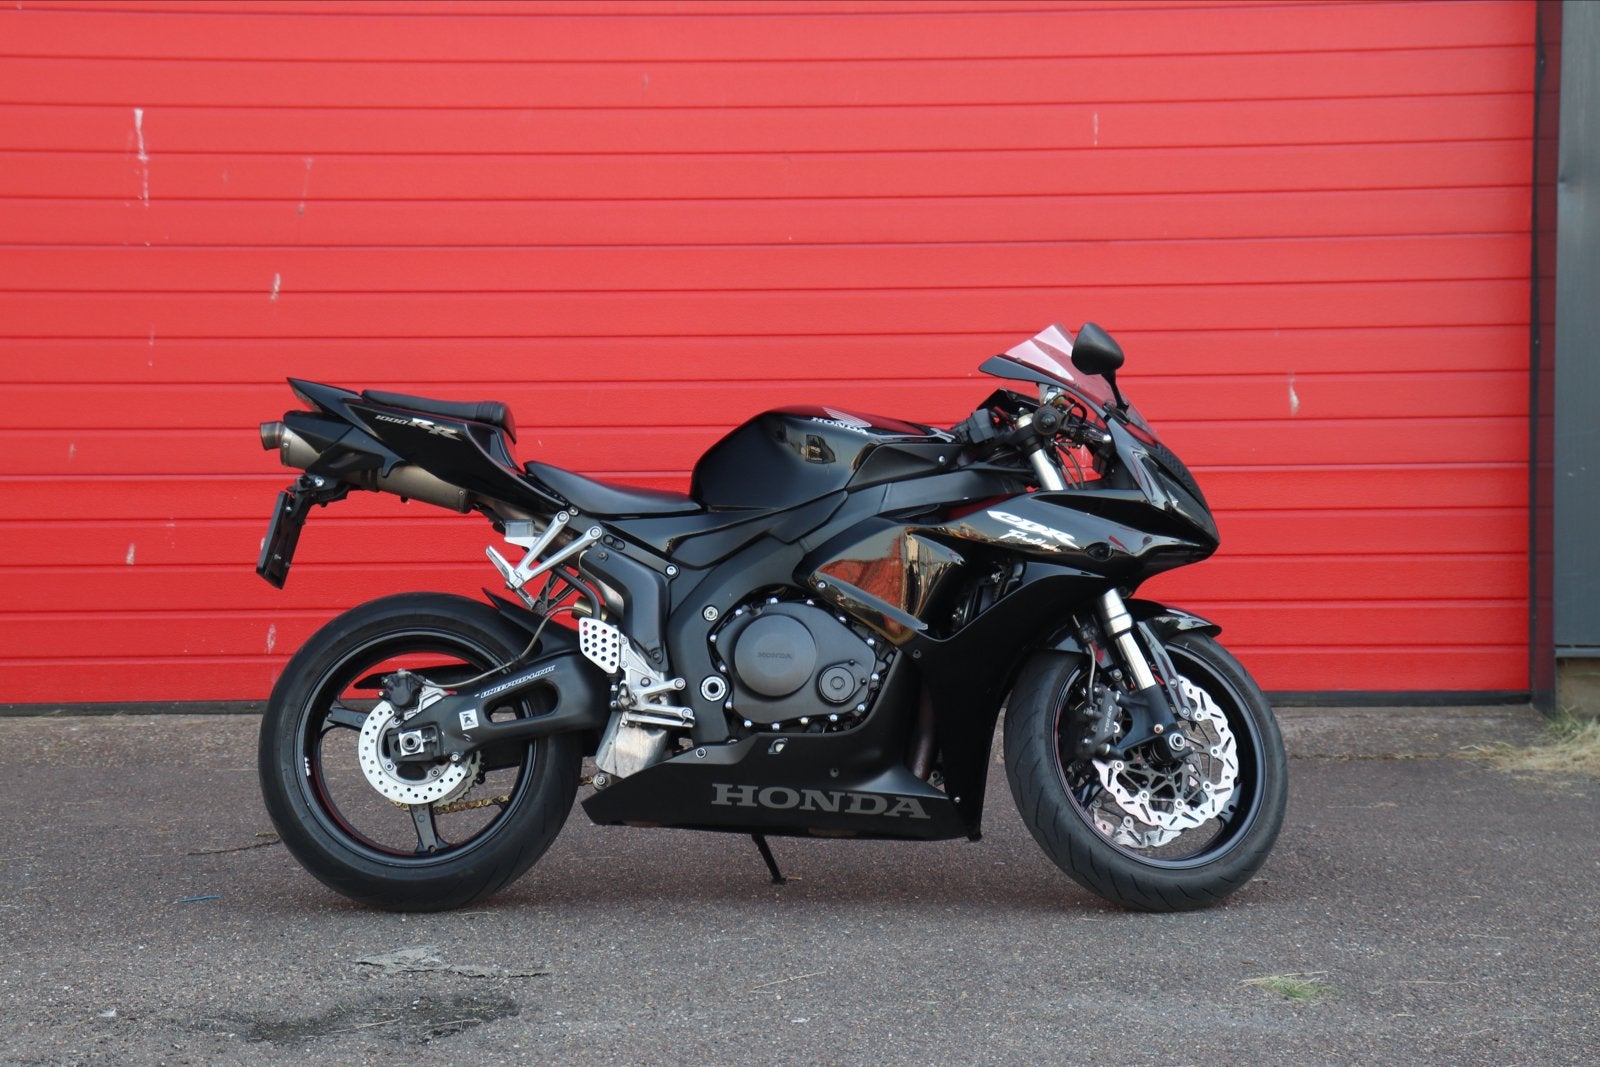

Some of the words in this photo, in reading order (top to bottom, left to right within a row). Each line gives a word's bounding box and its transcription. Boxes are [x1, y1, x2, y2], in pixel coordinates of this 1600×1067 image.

[812, 417, 868, 435] HONDA
[987, 510, 1081, 550] CBR
[711, 783, 931, 819] HONDA
